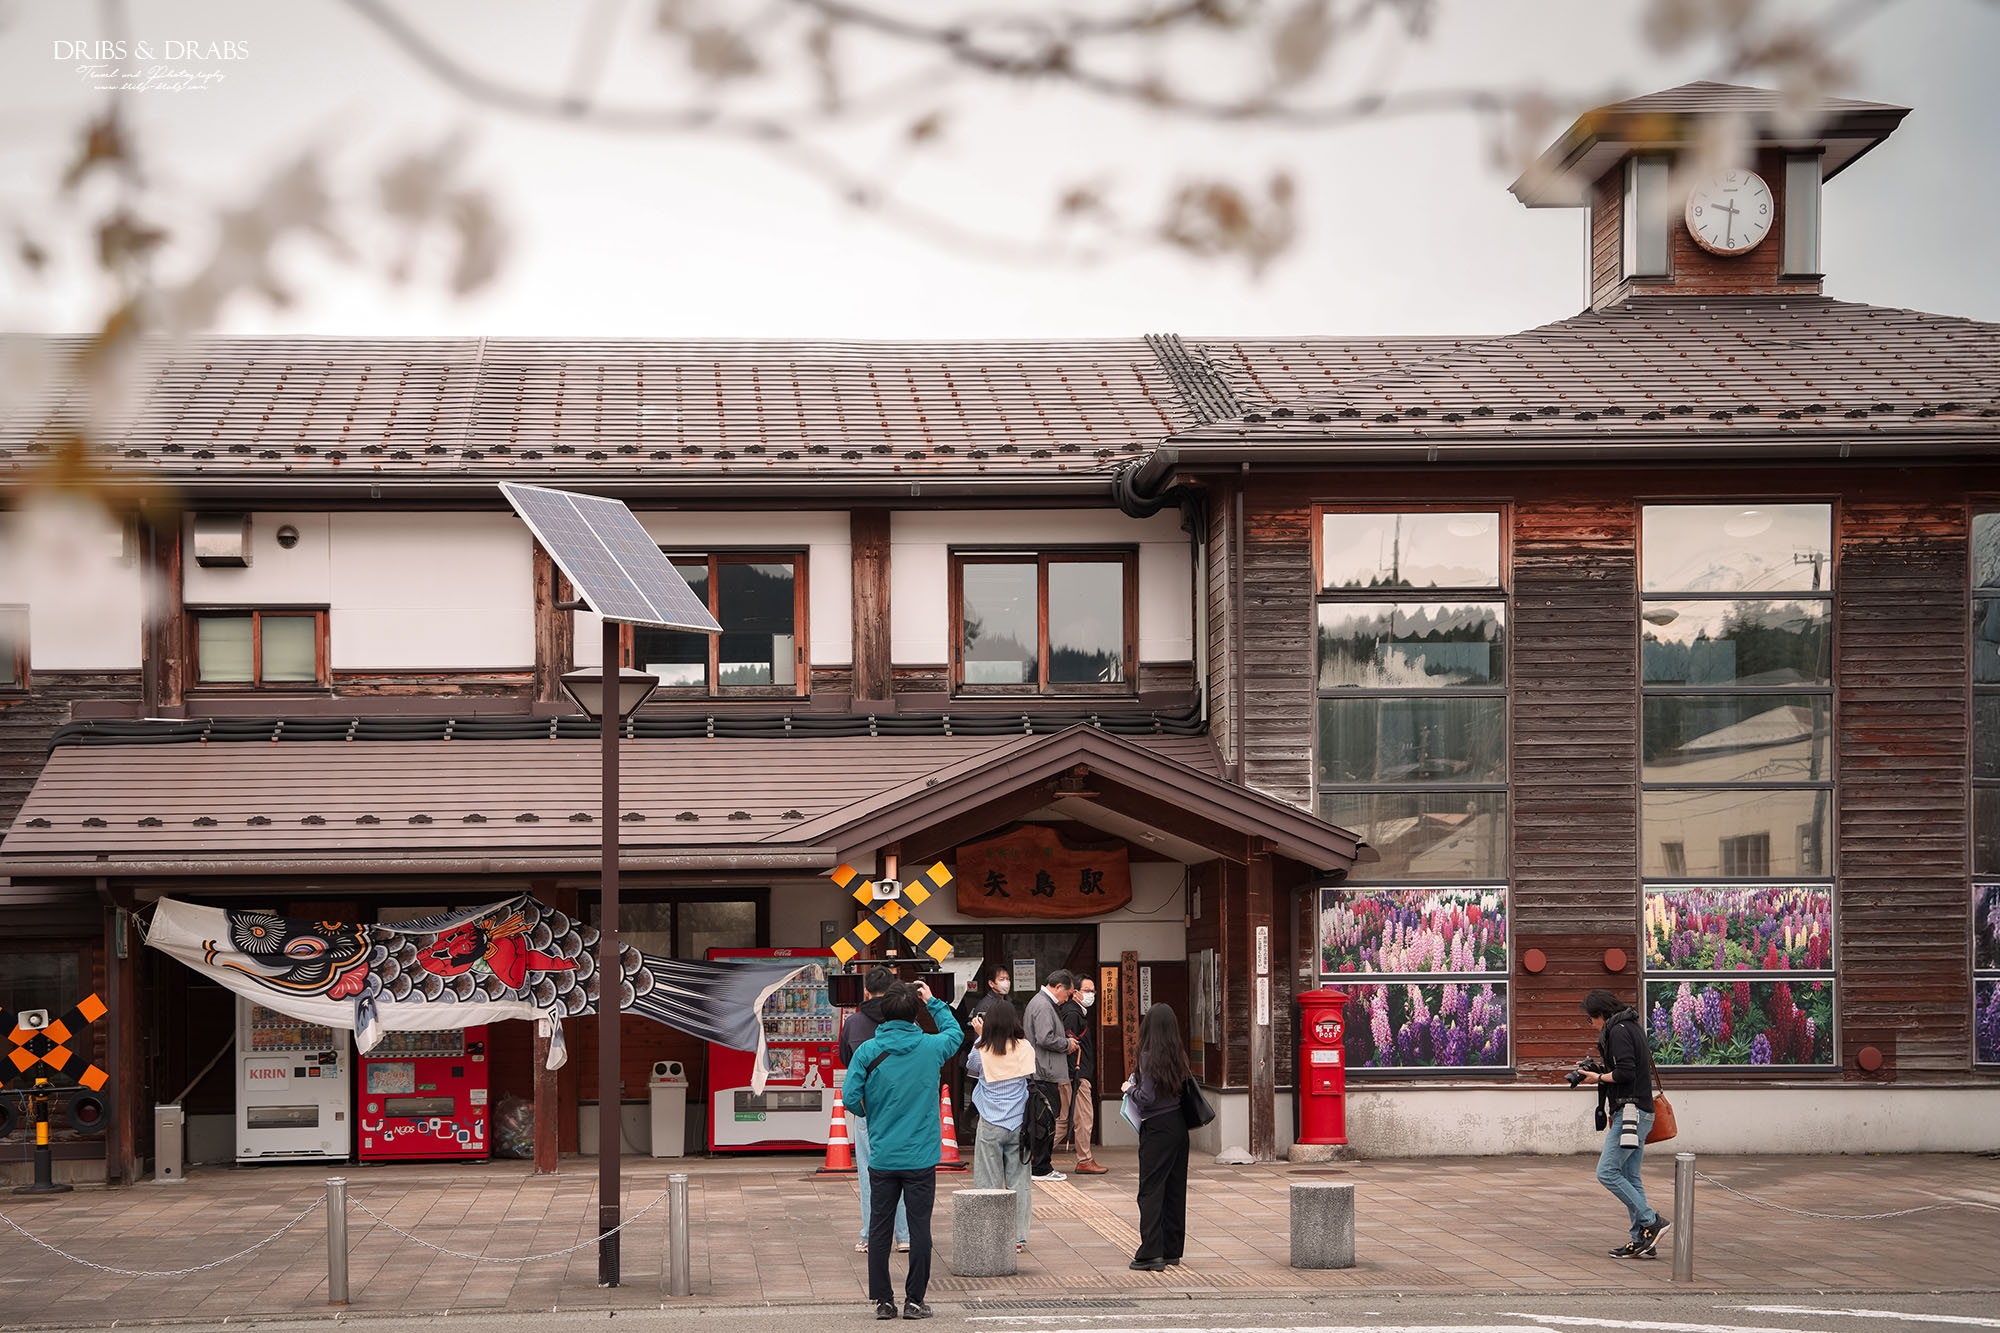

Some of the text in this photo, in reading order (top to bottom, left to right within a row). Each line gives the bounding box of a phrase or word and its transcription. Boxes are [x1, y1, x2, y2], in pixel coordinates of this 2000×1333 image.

[1726, 172, 1737, 183] 12
[1694, 206, 1703, 217] 9
[1759, 203, 1768, 215] 3
[1727, 238, 1735, 249] 6
[983, 868, 1106, 899] 矢島駅
[249, 1068, 287, 1080] KIRIN
